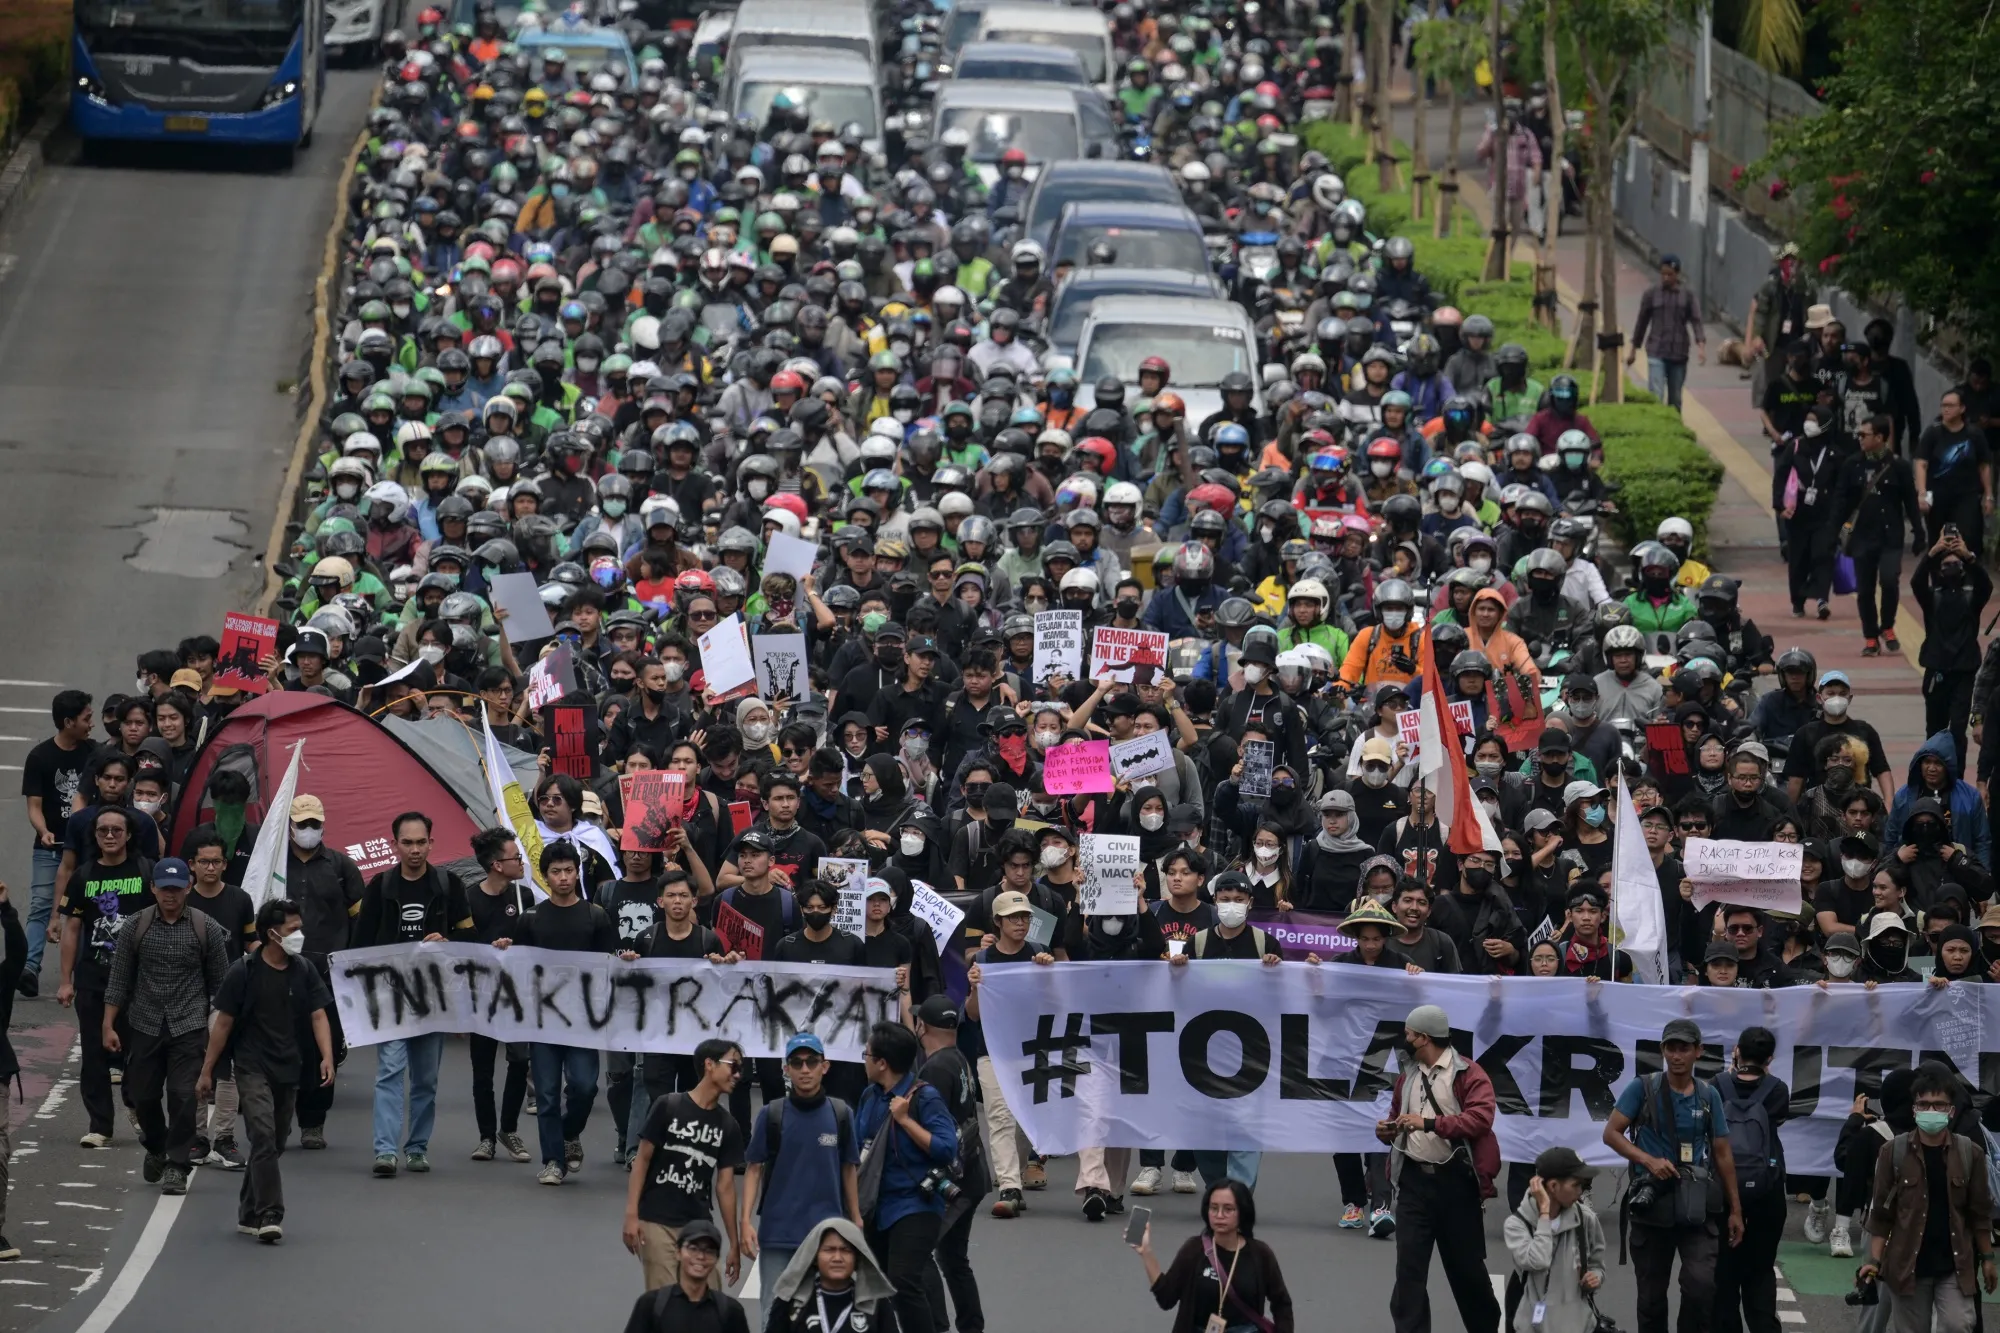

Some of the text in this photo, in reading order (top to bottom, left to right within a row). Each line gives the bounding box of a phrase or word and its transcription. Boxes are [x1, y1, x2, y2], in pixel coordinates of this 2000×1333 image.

[1036, 611, 1080, 622] KAYAK KURANG
[1037, 622, 1063, 631] KERJAAN
[1043, 631, 1070, 640] NGAMBIL
[1097, 628, 1165, 648] KEMBALIKAN
[1039, 640, 1075, 650] DOUBLE JOB
[1095, 645, 1111, 660] TNI
[1113, 647, 1127, 661] KE
[1401, 728, 1419, 744] TNI
[1046, 765, 1103, 778] OLEH MILITER
[365, 837, 388, 847] DHA
[1107, 841, 1137, 851] CIVIL
[367, 843, 390, 853] ULA
[369, 848, 393, 859] GIRI
[1700, 845, 1742, 860] RAKYAT
[374, 859, 391, 868] DOME
[390, 855, 398, 865] 2
[1096, 854, 1137, 864] SUPRE-
[1101, 868, 1137, 878] MACY
[85, 877, 142, 897] TOP PREDATOR
[844, 892, 862, 901] BANGET
[846, 908, 861, 916] SAMA
[912, 901, 944, 926] ER KE
[1275, 928, 1358, 949] Perempua
[344, 962, 447, 1030] TNI
[453, 960, 654, 1032] TAKUT
